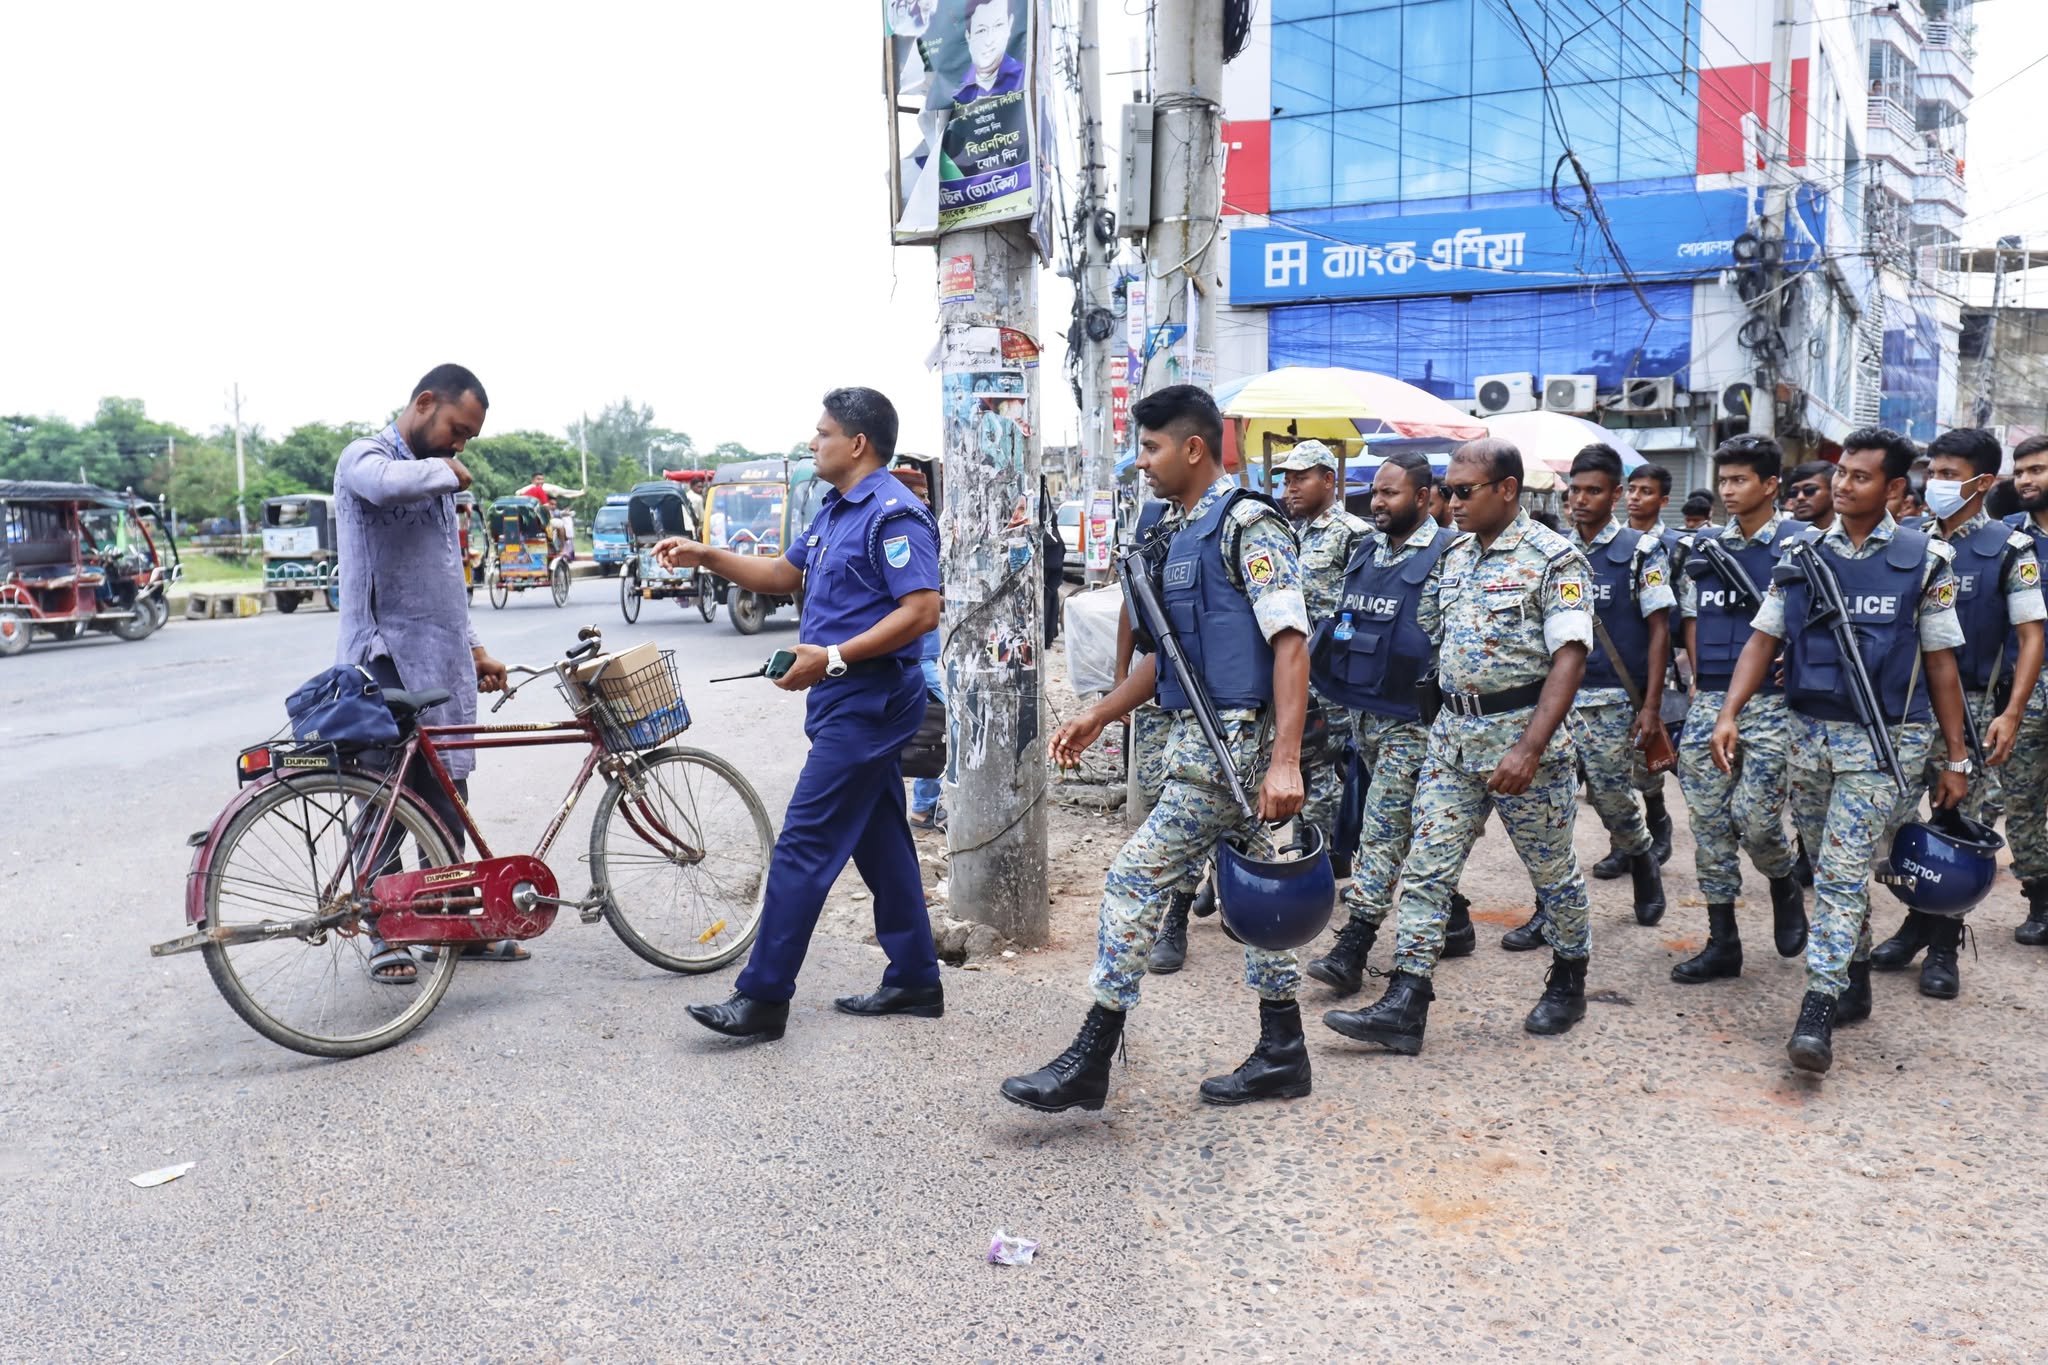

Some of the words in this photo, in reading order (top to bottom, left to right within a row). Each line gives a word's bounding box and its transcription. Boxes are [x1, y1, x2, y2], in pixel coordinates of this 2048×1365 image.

[965, 130, 1020, 157] বিএনপিতে
[976, 153, 1000, 170] যোগ
[1001, 147, 1018, 163] দিন
[1322, 240, 1417, 278] ব্যাংক
[1426, 227, 1526, 272] এশিয়া
[1677, 239, 1735, 257] গোপালগ
[1165, 565, 1187, 582] LICE
[1343, 593, 1398, 615] POLICE
[1842, 595, 1897, 614] LICE
[285, 758, 327, 767] DURANTA
[426, 871, 461, 883] DURANTA
[1902, 858, 1942, 884] POLICE
